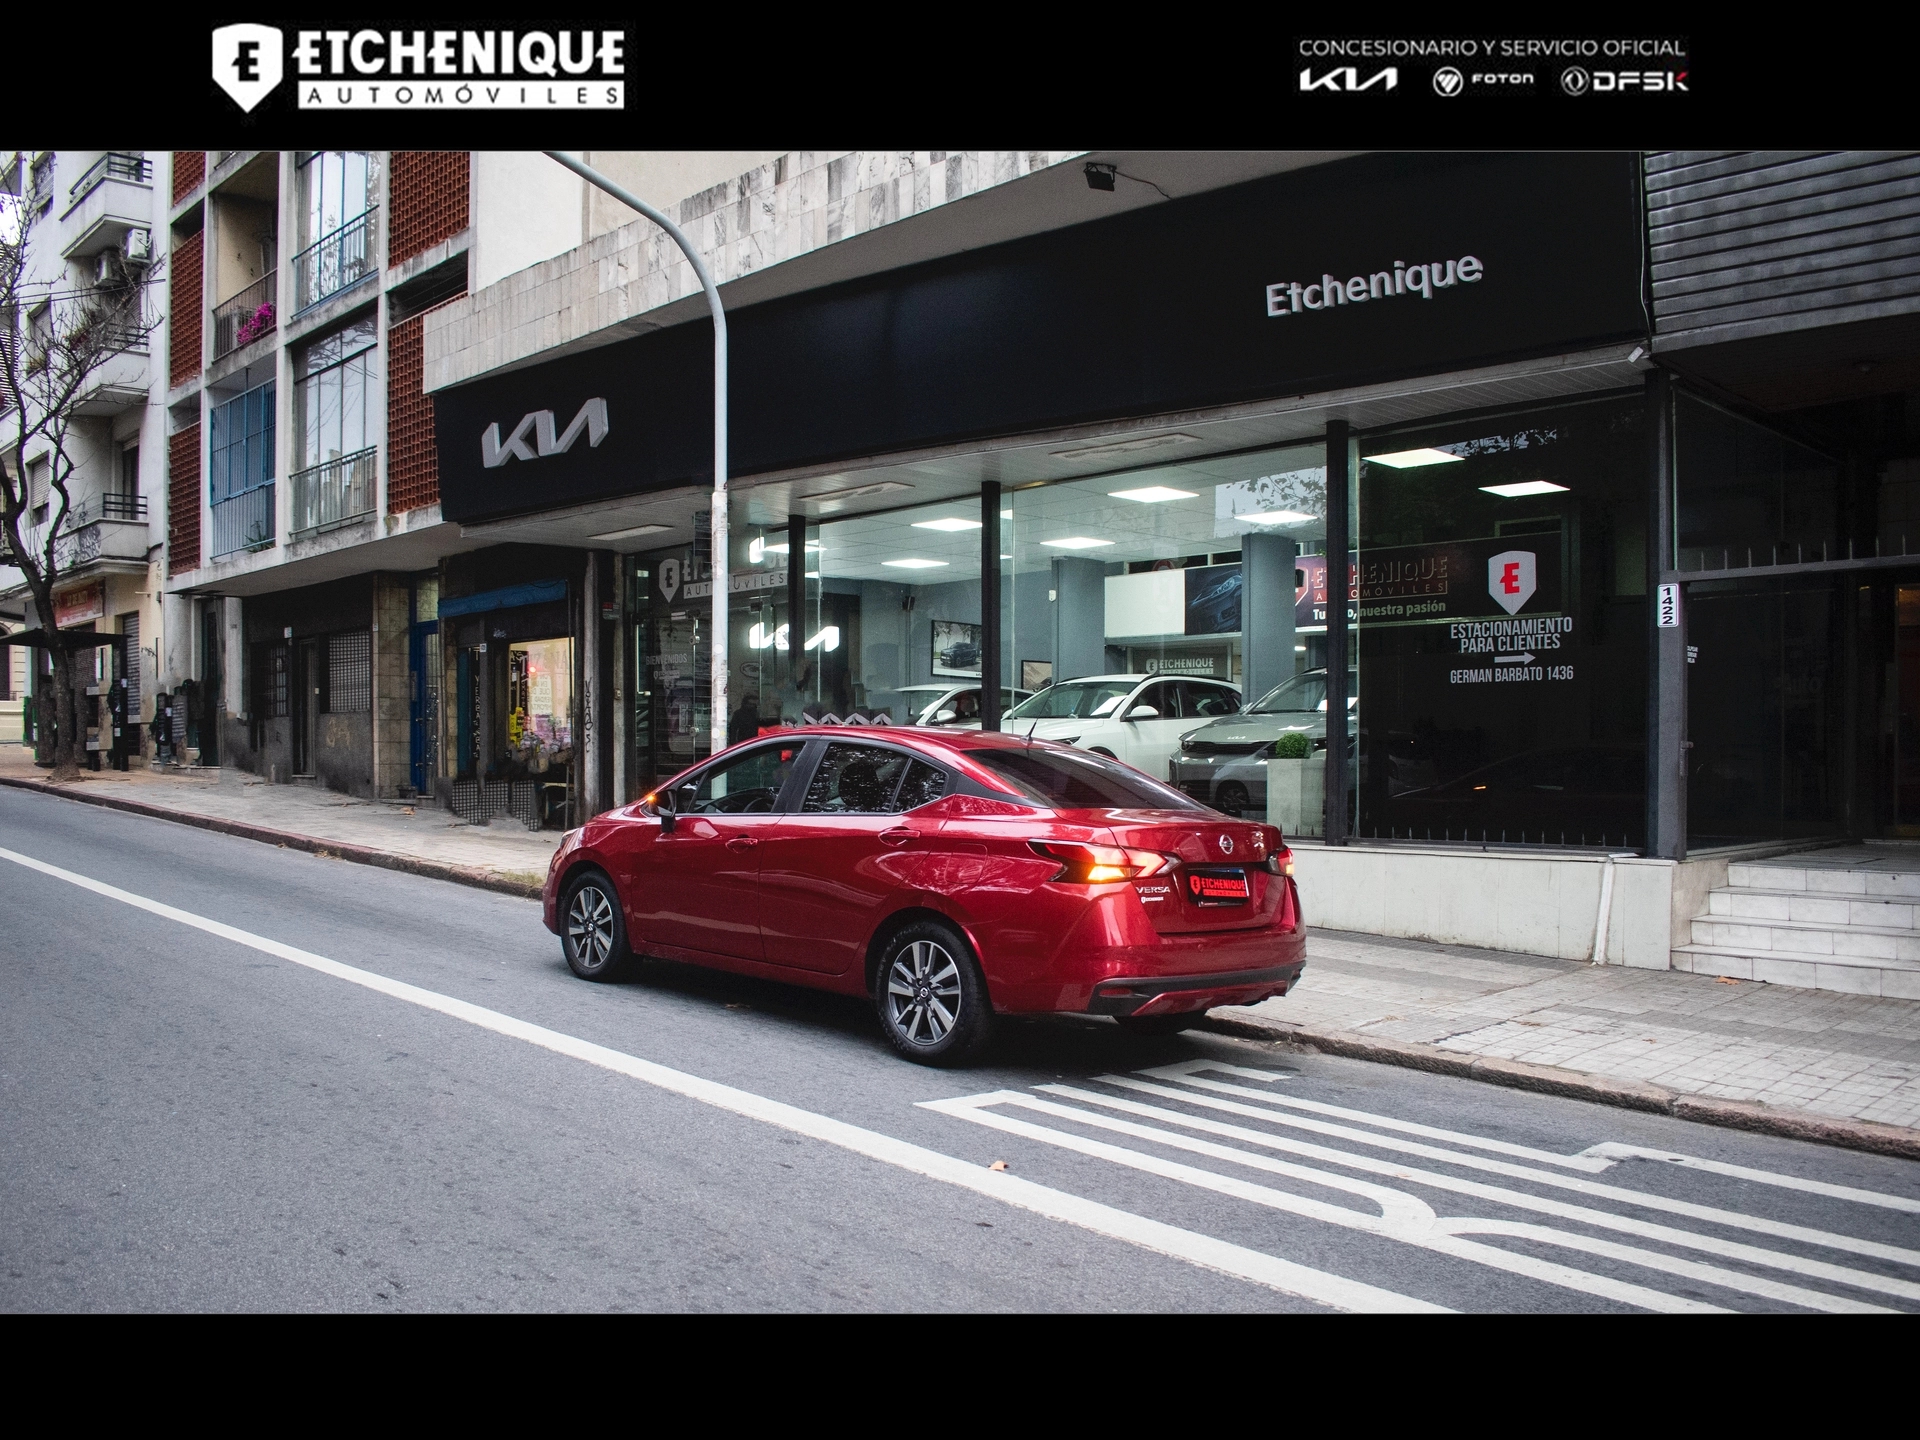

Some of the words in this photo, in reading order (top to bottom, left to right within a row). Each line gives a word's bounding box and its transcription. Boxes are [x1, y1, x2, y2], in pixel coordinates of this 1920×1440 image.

[1265, 255, 1484, 317] Etchenique
[481, 397, 609, 469] KIA
[1310, 556, 1448, 589] EHENIQUE
[686, 573, 785, 597] AUTÓVILES
[1315, 582, 1445, 601] AOMÓVILES
[1359, 603, 1403, 617] nuestra
[1406, 599, 1446, 617] pasión
[1662, 587, 1674, 625] 1422
[1450, 616, 1573, 639] ESTACIONAMIENTO
[1460, 637, 1495, 654] PARA
[1497, 633, 1561, 652] CLIENTES
[1158, 658, 1214, 669] ETCHENIQUE
[1450, 668, 1493, 684] GERMAN
[1494, 666, 1543, 682] BARBATO
[1546, 665, 1574, 681] 1436
[1135, 886, 1171, 894] VERSA
[1200, 877, 1247, 890] ETCHENIQUE
